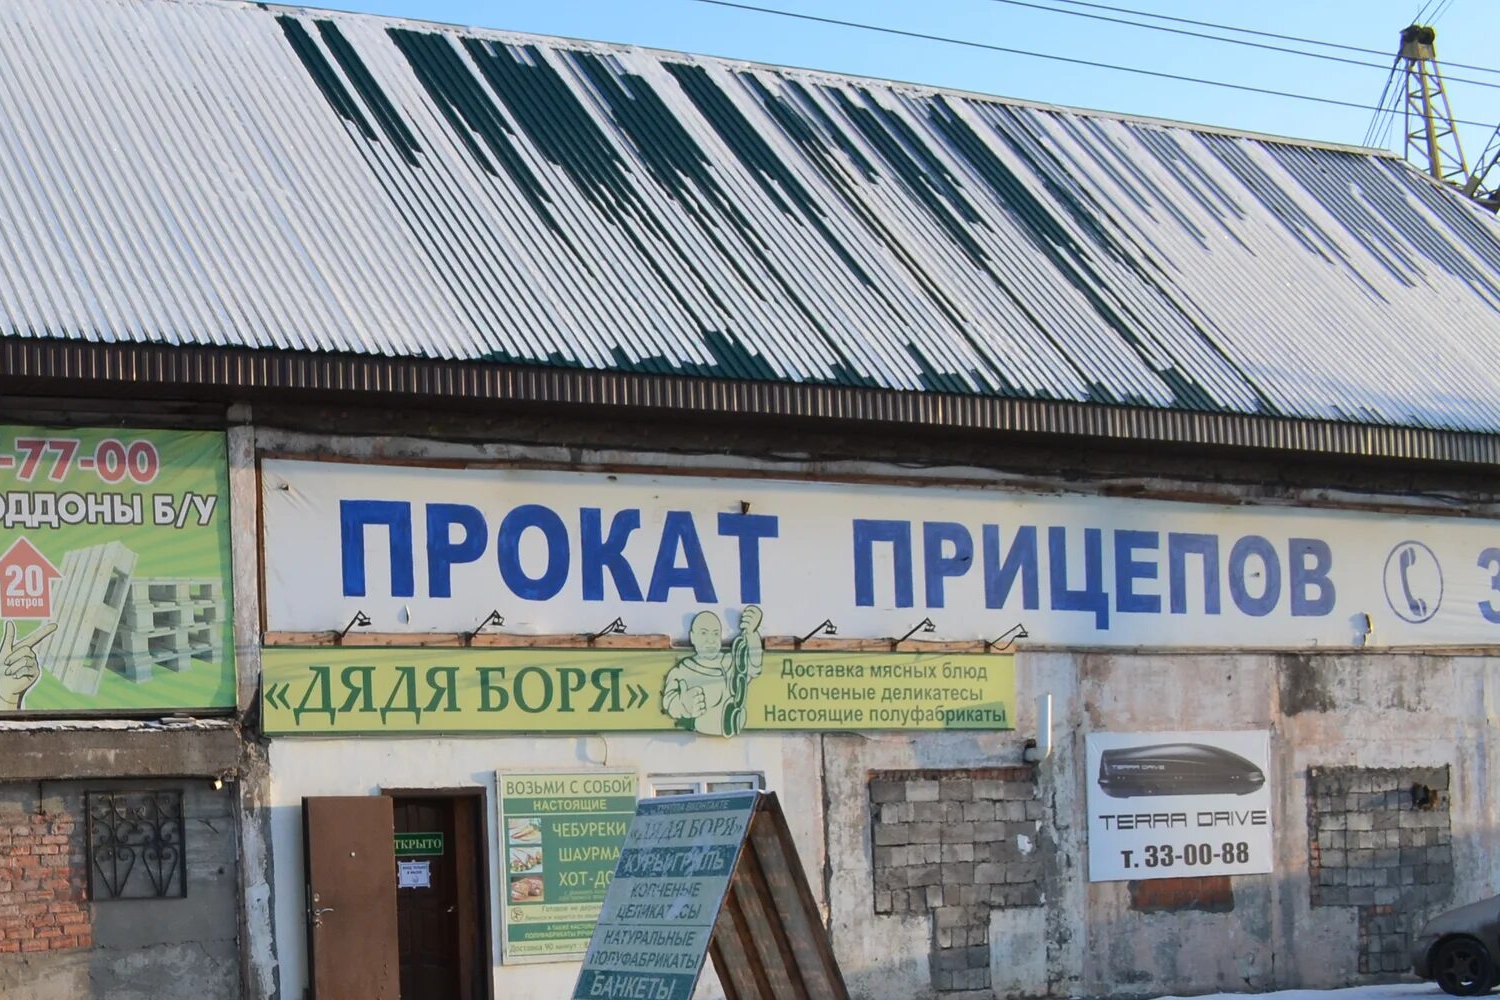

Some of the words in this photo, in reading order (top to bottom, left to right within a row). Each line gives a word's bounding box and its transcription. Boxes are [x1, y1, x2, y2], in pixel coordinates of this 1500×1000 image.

[153, 491, 217, 527] Б/У
[339, 499, 779, 605] ПРОКАТ
[852, 518, 1337, 630] ПРИЦЕПОВ
[5, 564, 44, 596] 20
[6, 597, 44, 609] метров
[781, 658, 864, 679] Доставка
[870, 663, 937, 679] мясных
[942, 661, 989, 682] блюд
[264, 666, 461, 726] «ДЯДЯ
[475, 667, 650, 714] БОРЯ»
[787, 682, 876, 701] Копченые
[881, 686, 984, 703] деликатесы
[764, 704, 863, 724] Настоящие
[869, 705, 1007, 726] полуфабрикаты
[506, 781, 565, 795] ВОЗЬМИ
[570, 780, 579, 794] С
[583, 776, 632, 794] СОБОЙ
[533, 799, 607, 812] НАСТОЯЩИЕ
[552, 821, 626, 838] ЧЕБУРЕКИ
[1099, 811, 1188, 831] TERRA
[1196, 810, 1267, 827] DRIVE
[393, 839, 442, 849] ТКРЫТО
[558, 846, 620, 862] ШАУРМА
[1144, 841, 1250, 868] 33-00-88
[558, 870, 613, 889] ХОТ-ДО
[603, 929, 697, 946] НАТУРАЛЬНЫЕ
[589, 950, 700, 969] ПОЛУФАБРИКАТЫ
[590, 972, 676, 1000] БАНКЕТЫ
